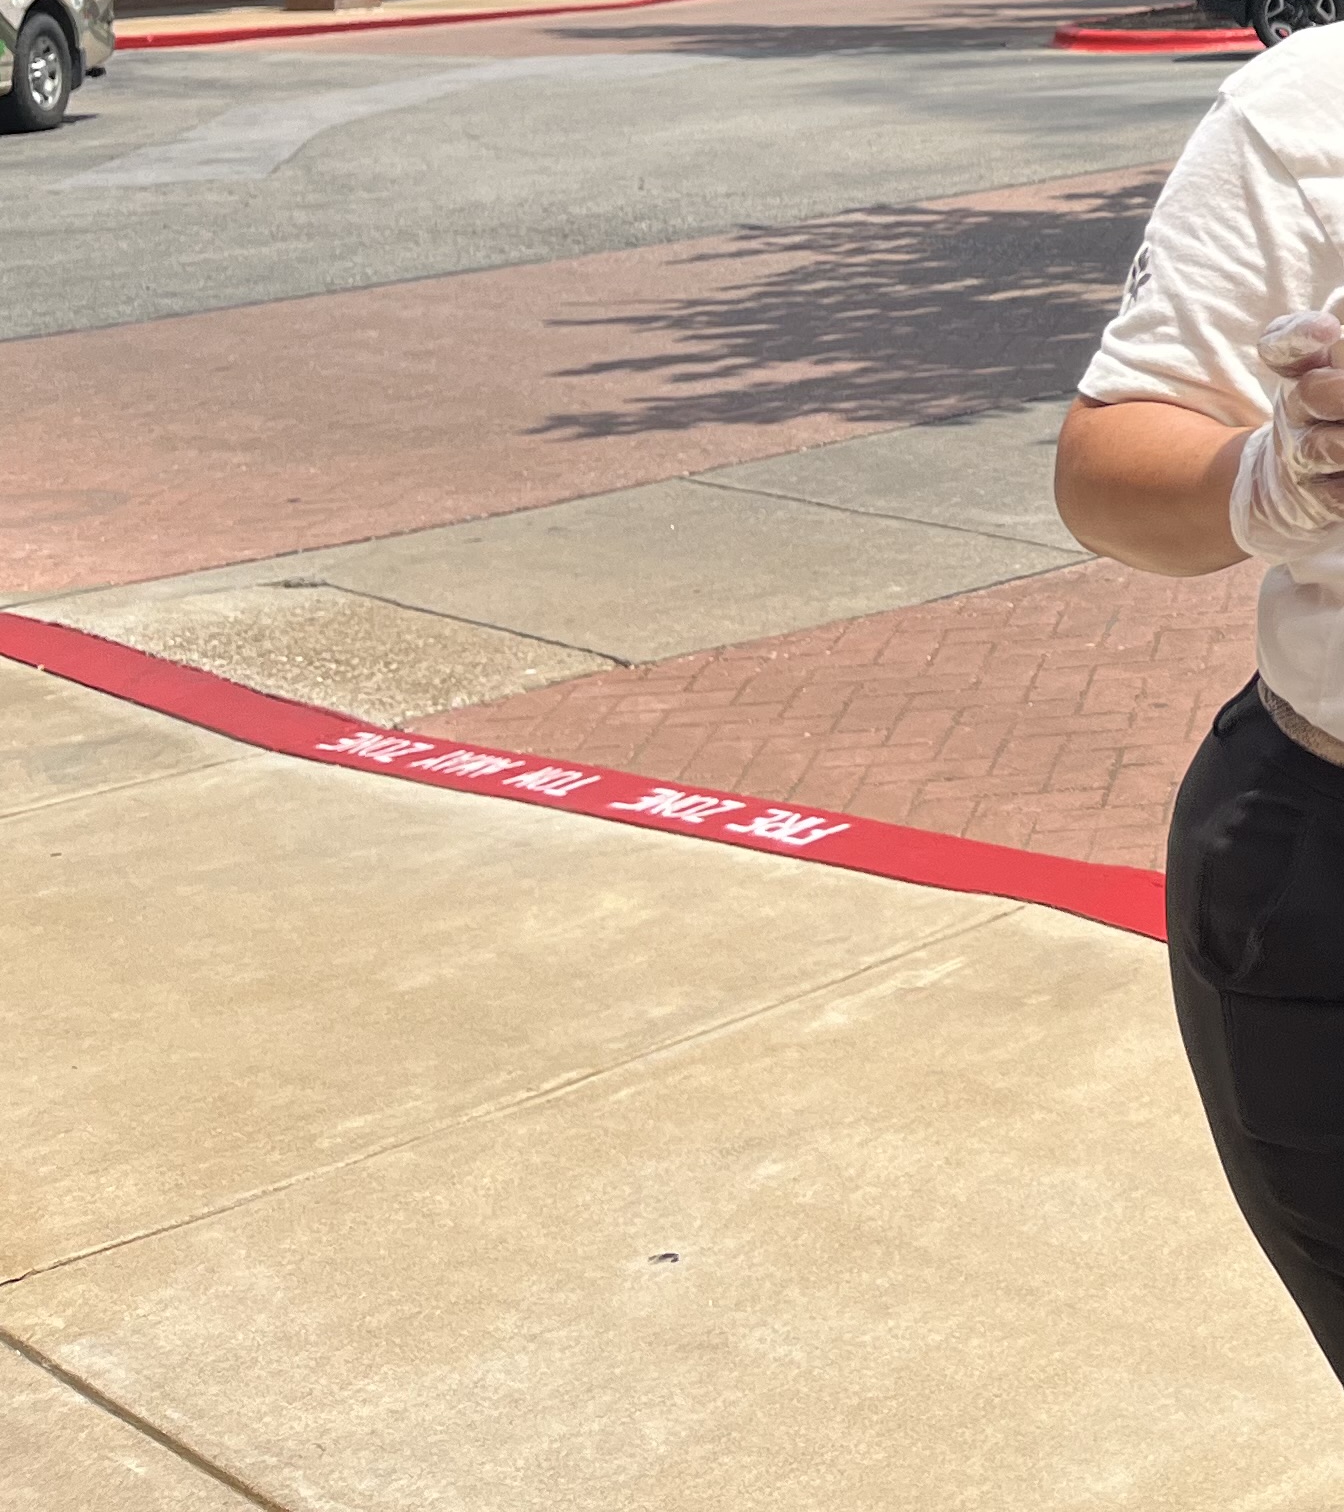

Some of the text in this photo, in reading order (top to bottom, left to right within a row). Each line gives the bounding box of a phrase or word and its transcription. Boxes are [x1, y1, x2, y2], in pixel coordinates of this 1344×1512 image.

[315, 731, 435, 764] ZONE
[609, 786, 746, 825] ZONE
[725, 806, 852, 846] FIRE
